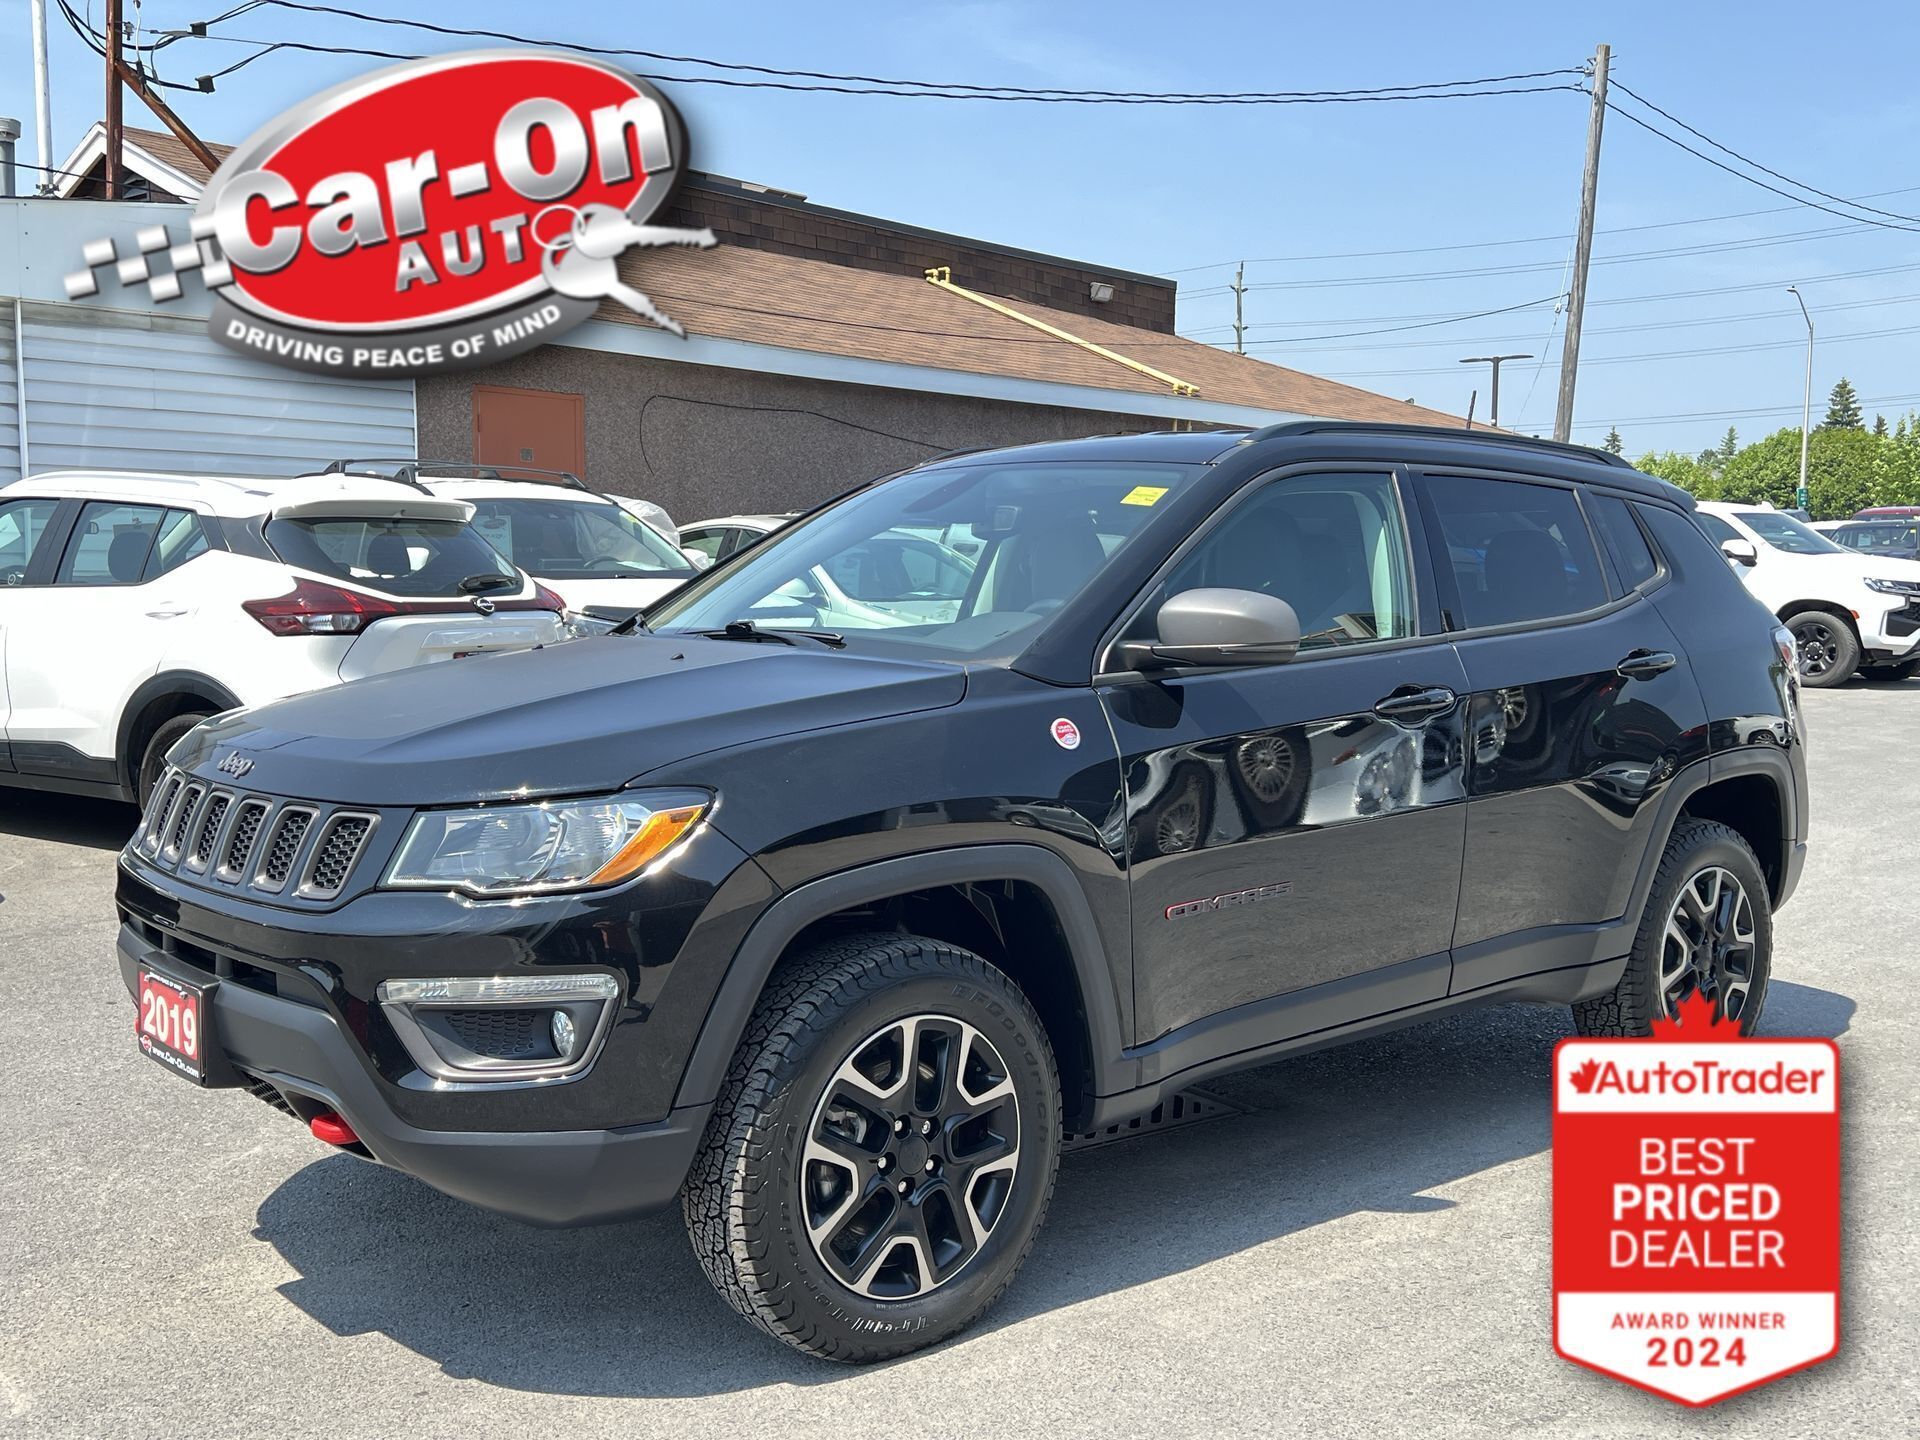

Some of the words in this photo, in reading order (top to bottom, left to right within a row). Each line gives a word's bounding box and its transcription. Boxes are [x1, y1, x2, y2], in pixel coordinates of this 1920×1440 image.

[217, 750, 255, 780] Jeep
[1165, 881, 1294, 920] COMPASS
[142, 988, 197, 1056] 2019
